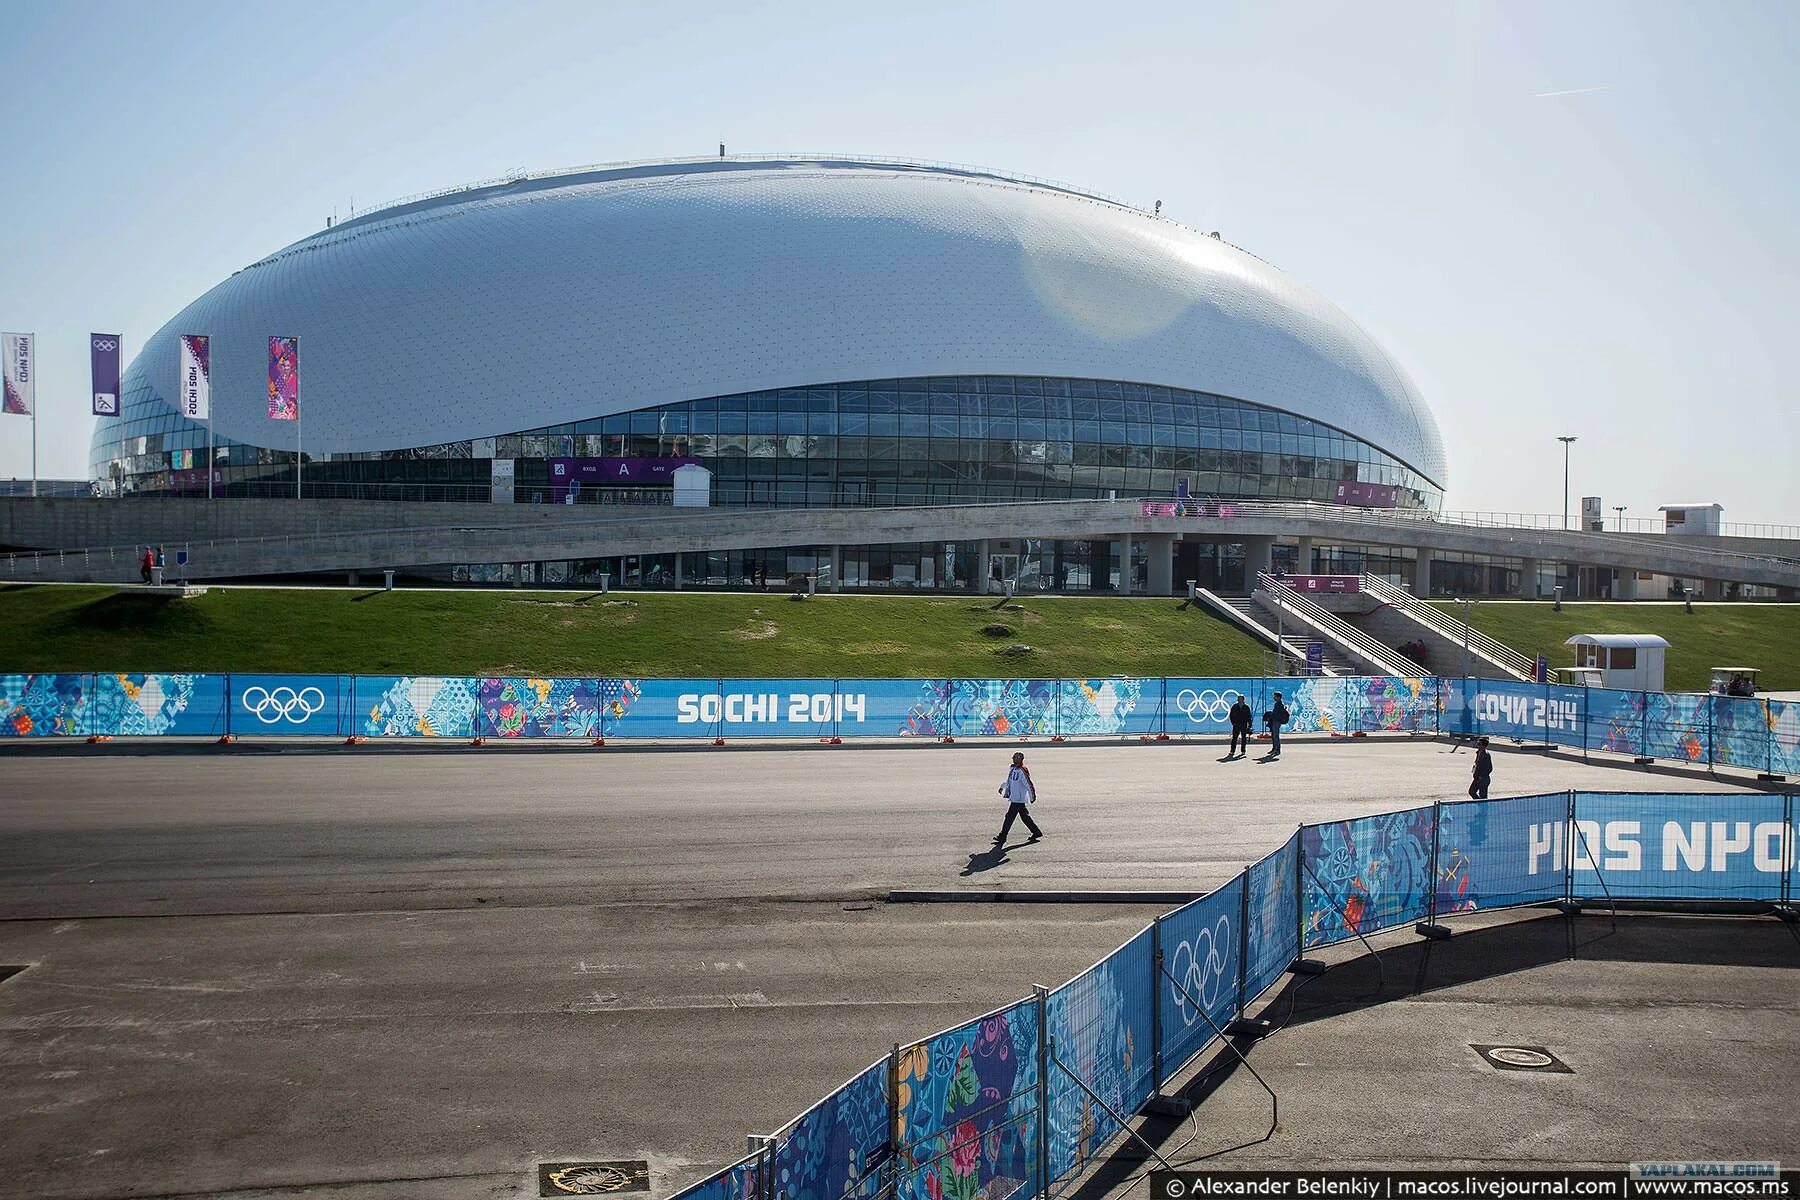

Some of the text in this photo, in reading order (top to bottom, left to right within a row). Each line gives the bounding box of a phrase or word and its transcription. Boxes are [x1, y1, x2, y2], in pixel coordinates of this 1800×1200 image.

[677, 693, 866, 723] SOCHI 2014
[1476, 693, 1577, 732] СОЧИ 2014
